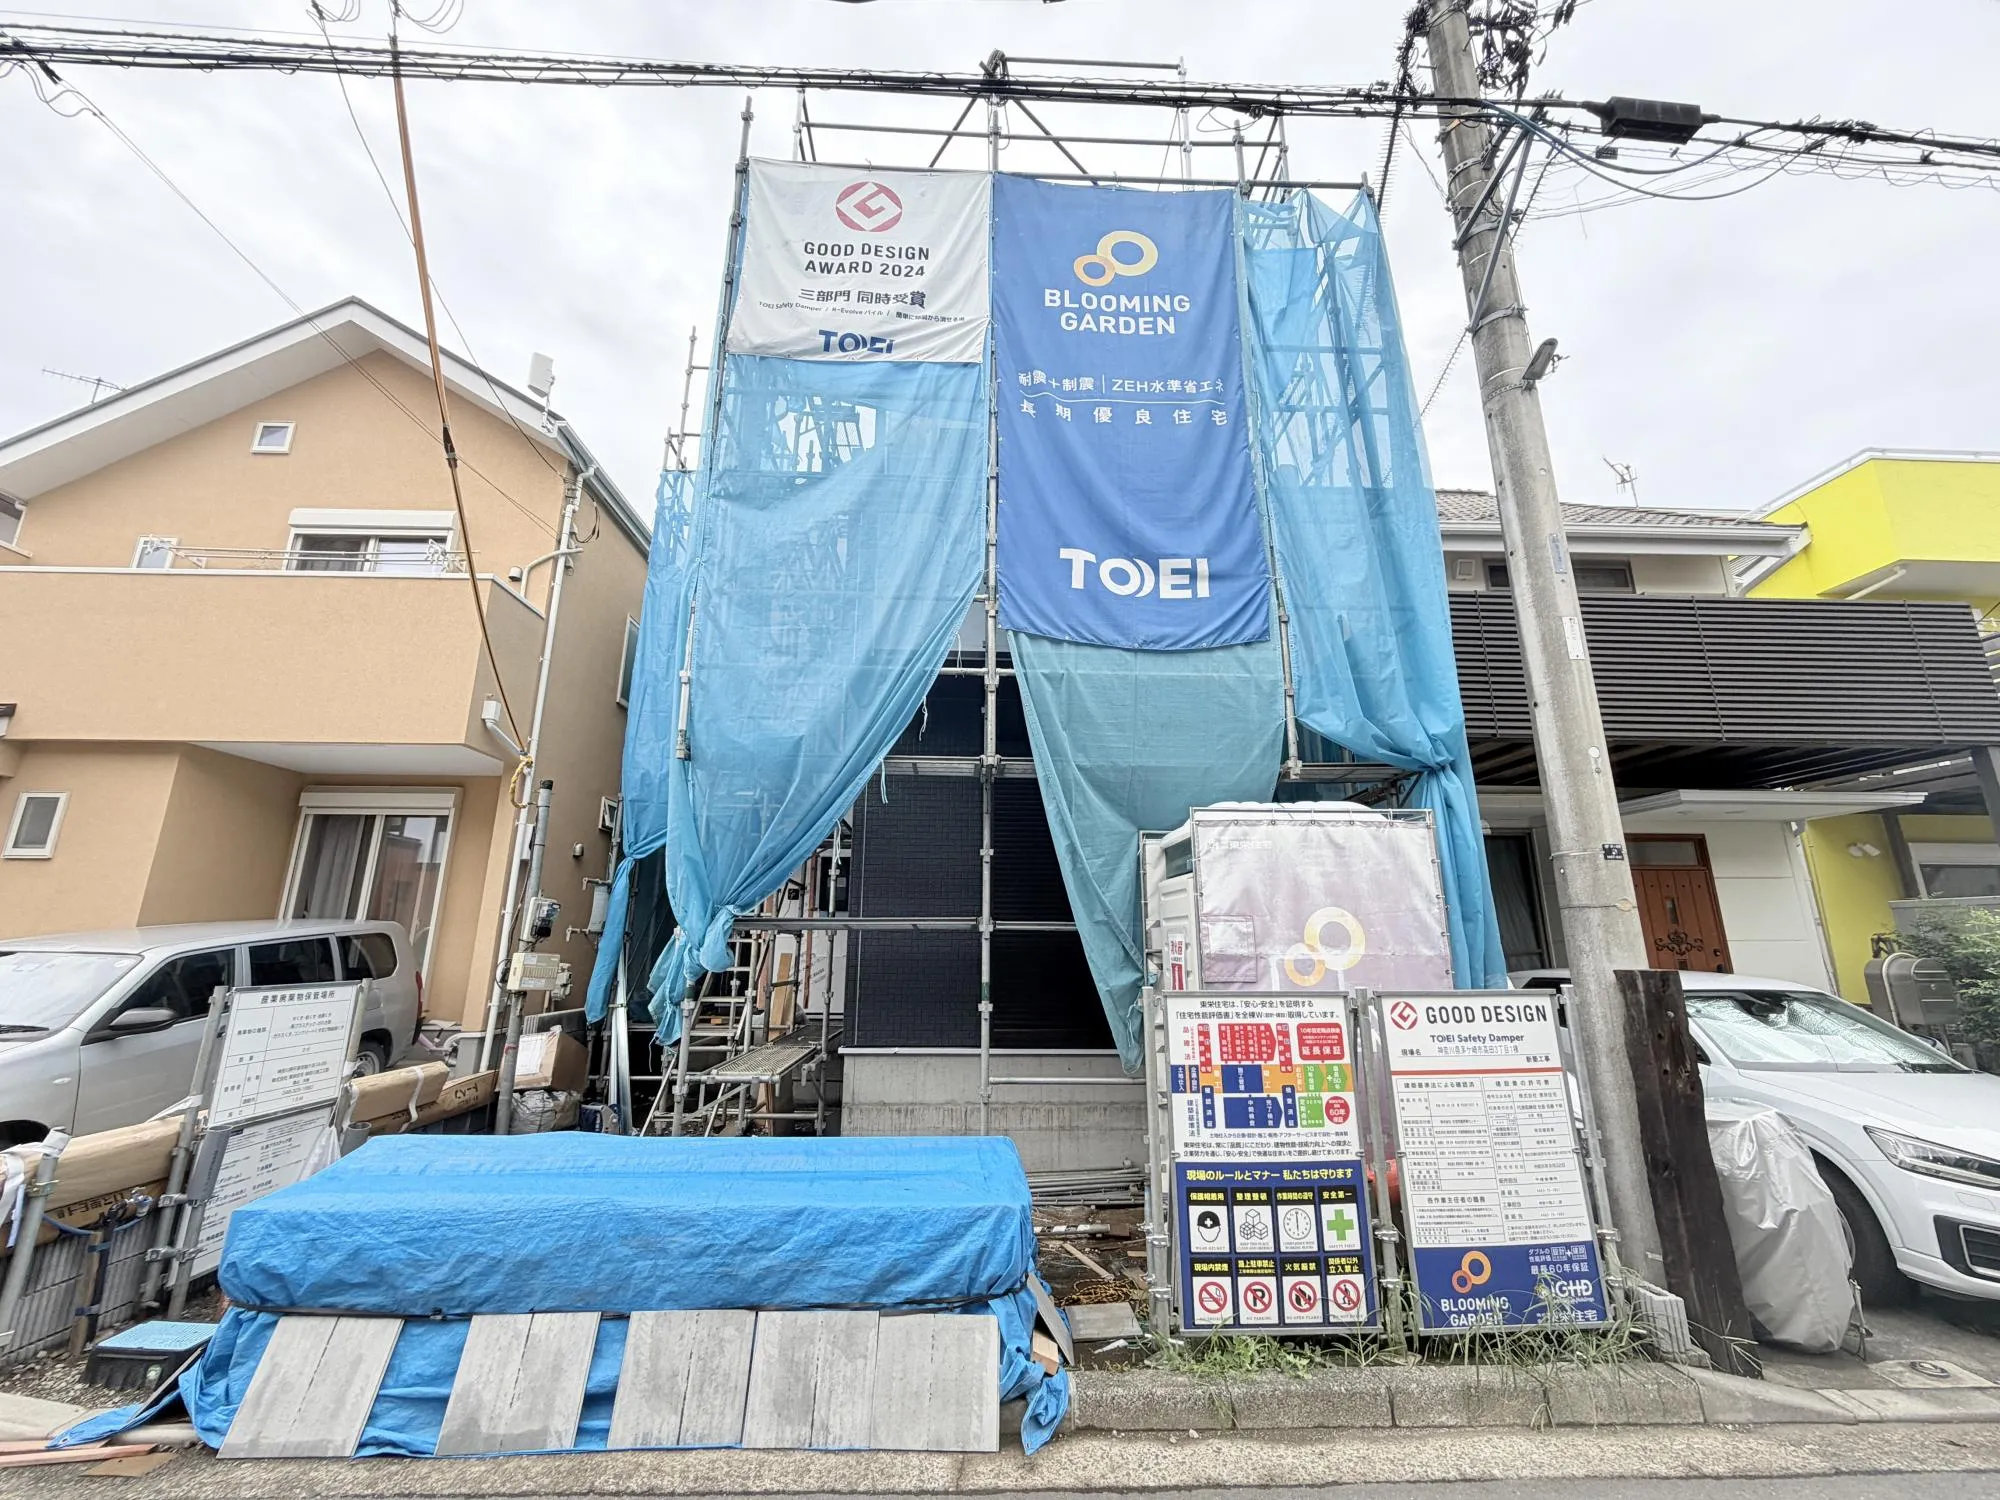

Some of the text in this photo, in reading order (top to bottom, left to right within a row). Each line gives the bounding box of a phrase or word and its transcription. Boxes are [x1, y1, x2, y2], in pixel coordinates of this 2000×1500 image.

[804, 241, 930, 260] GOOD DESIGN
[804, 260, 926, 278] AWARD 2024
[798, 288, 926, 309] 三部門 同時受賞
[1044, 288, 1191, 313] BLOOMING
[1060, 312, 1176, 335] GARDEN
[819, 329, 896, 354] TOEI
[1020, 398, 1229, 426] 長期優良住宅
[1059, 547, 1211, 599] TOEI
[1426, 1004, 1548, 1024] GOOD DESIGN
[1457, 1034, 1487, 1044] Safety
[1489, 1034, 1525, 1043] Damper
[1401, 1048, 1422, 1056] 現場名
[1526, 1055, 1551, 1063] 新築工事
[1186, 1168, 1354, 1181] 現場のルールとマナー 私たちは守ります
[1323, 1190, 1352, 1199] 安全第一
[1285, 1263, 1316, 1271] 火気厳禁
[1328, 1257, 1358, 1265] 関係者以外
[1329, 1265, 1359, 1273] 立入禁止
[1441, 1296, 1509, 1311] BLOOMING
